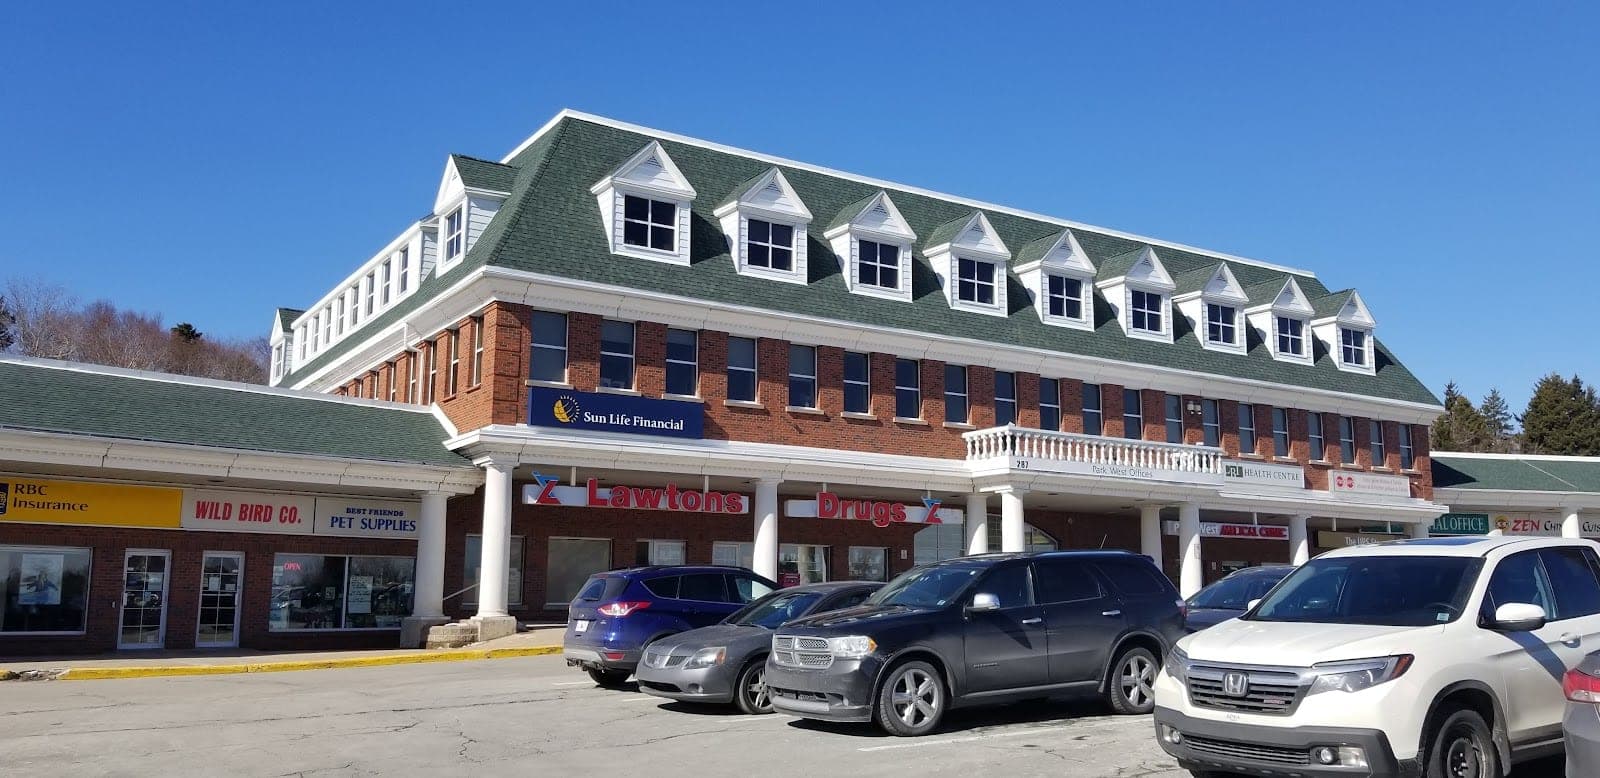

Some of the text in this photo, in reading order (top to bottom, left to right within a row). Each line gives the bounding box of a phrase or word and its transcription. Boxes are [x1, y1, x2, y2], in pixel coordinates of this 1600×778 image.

[583, 411, 684, 431] Sun Life Financial
[1092, 465, 1153, 478] Park West Offices
[1244, 468, 1300, 481] HEALTH CENTRE
[14, 483, 48, 496] RBC
[586, 477, 744, 514] Lawtons
[13, 497, 89, 512] Insurance
[346, 507, 404, 517] BEST FRIENDS
[816, 491, 907, 528] Drugs
[195, 501, 302, 524] WILD BIRD CO.
[330, 516, 417, 532] PET SUPPLIES
[1449, 516, 1484, 532] OFFICE
[1511, 519, 1600, 533] ZEN CHIN CUIS
[283, 563, 301, 571] OPEN
